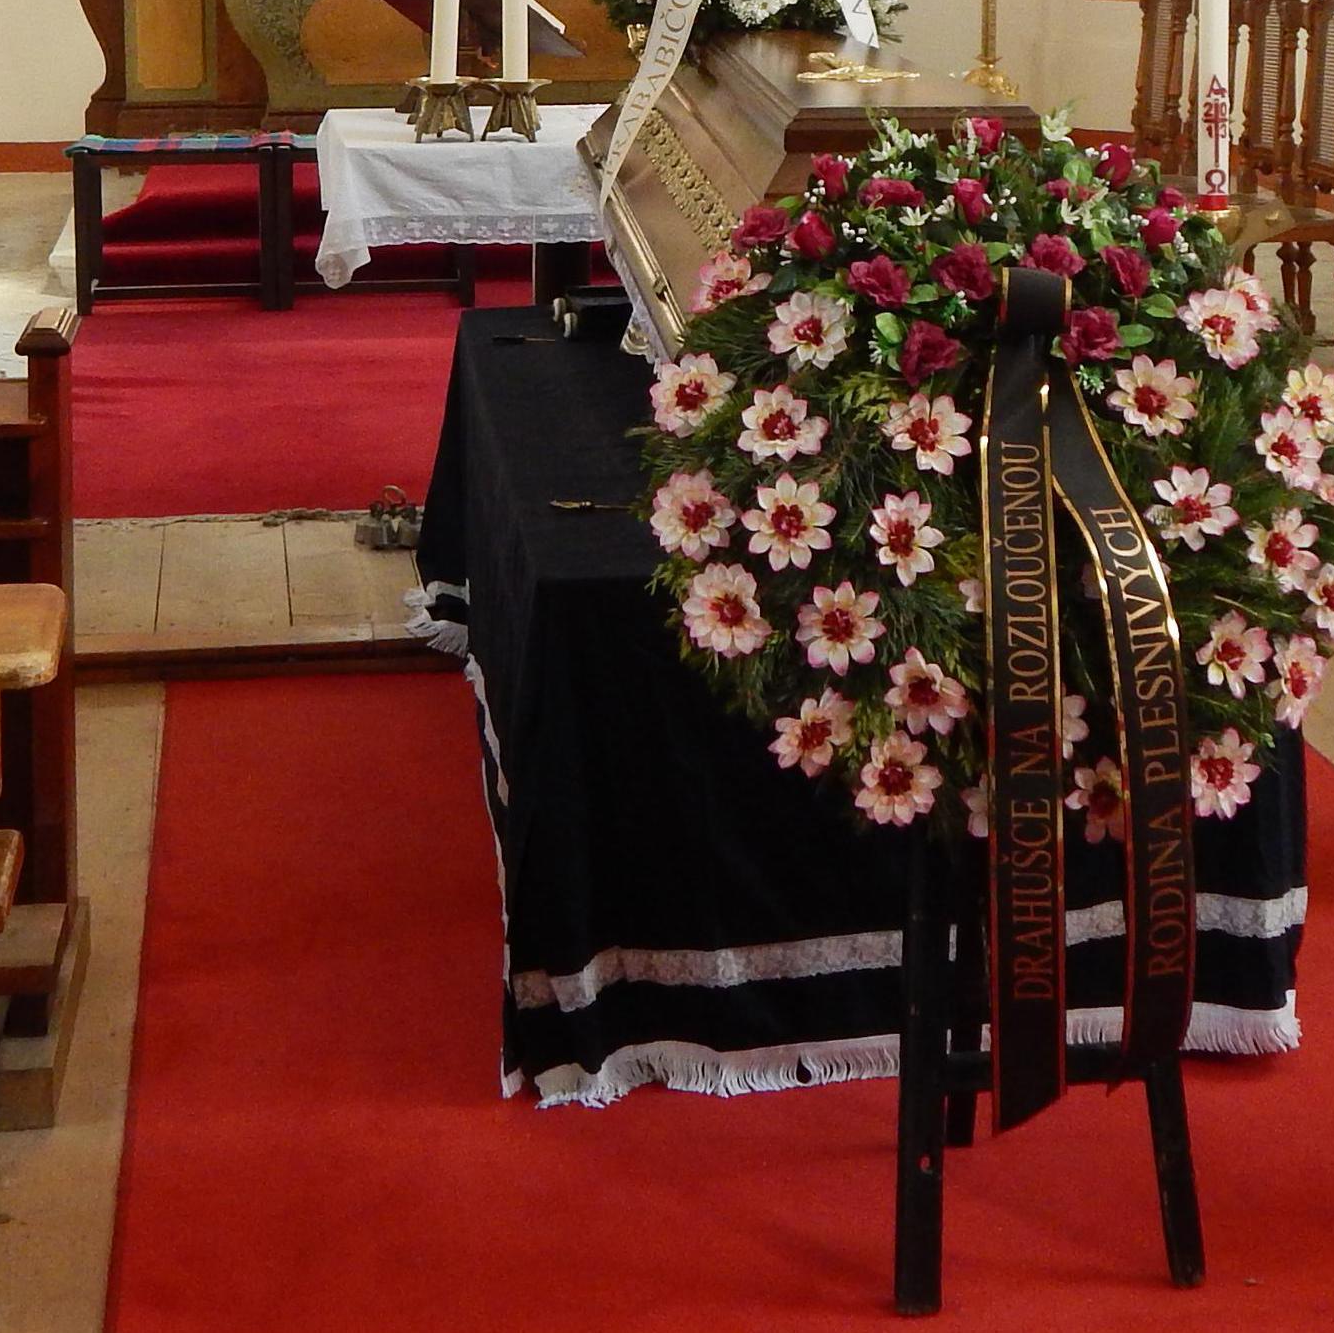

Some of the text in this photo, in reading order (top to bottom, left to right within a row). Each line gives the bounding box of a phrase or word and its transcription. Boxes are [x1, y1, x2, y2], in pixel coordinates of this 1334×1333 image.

[992, 440, 1054, 1001] DRAHUŠCE NA ROZLOUČENOU
[1089, 506, 1187, 979] RODINA PLESNIVÝCH
